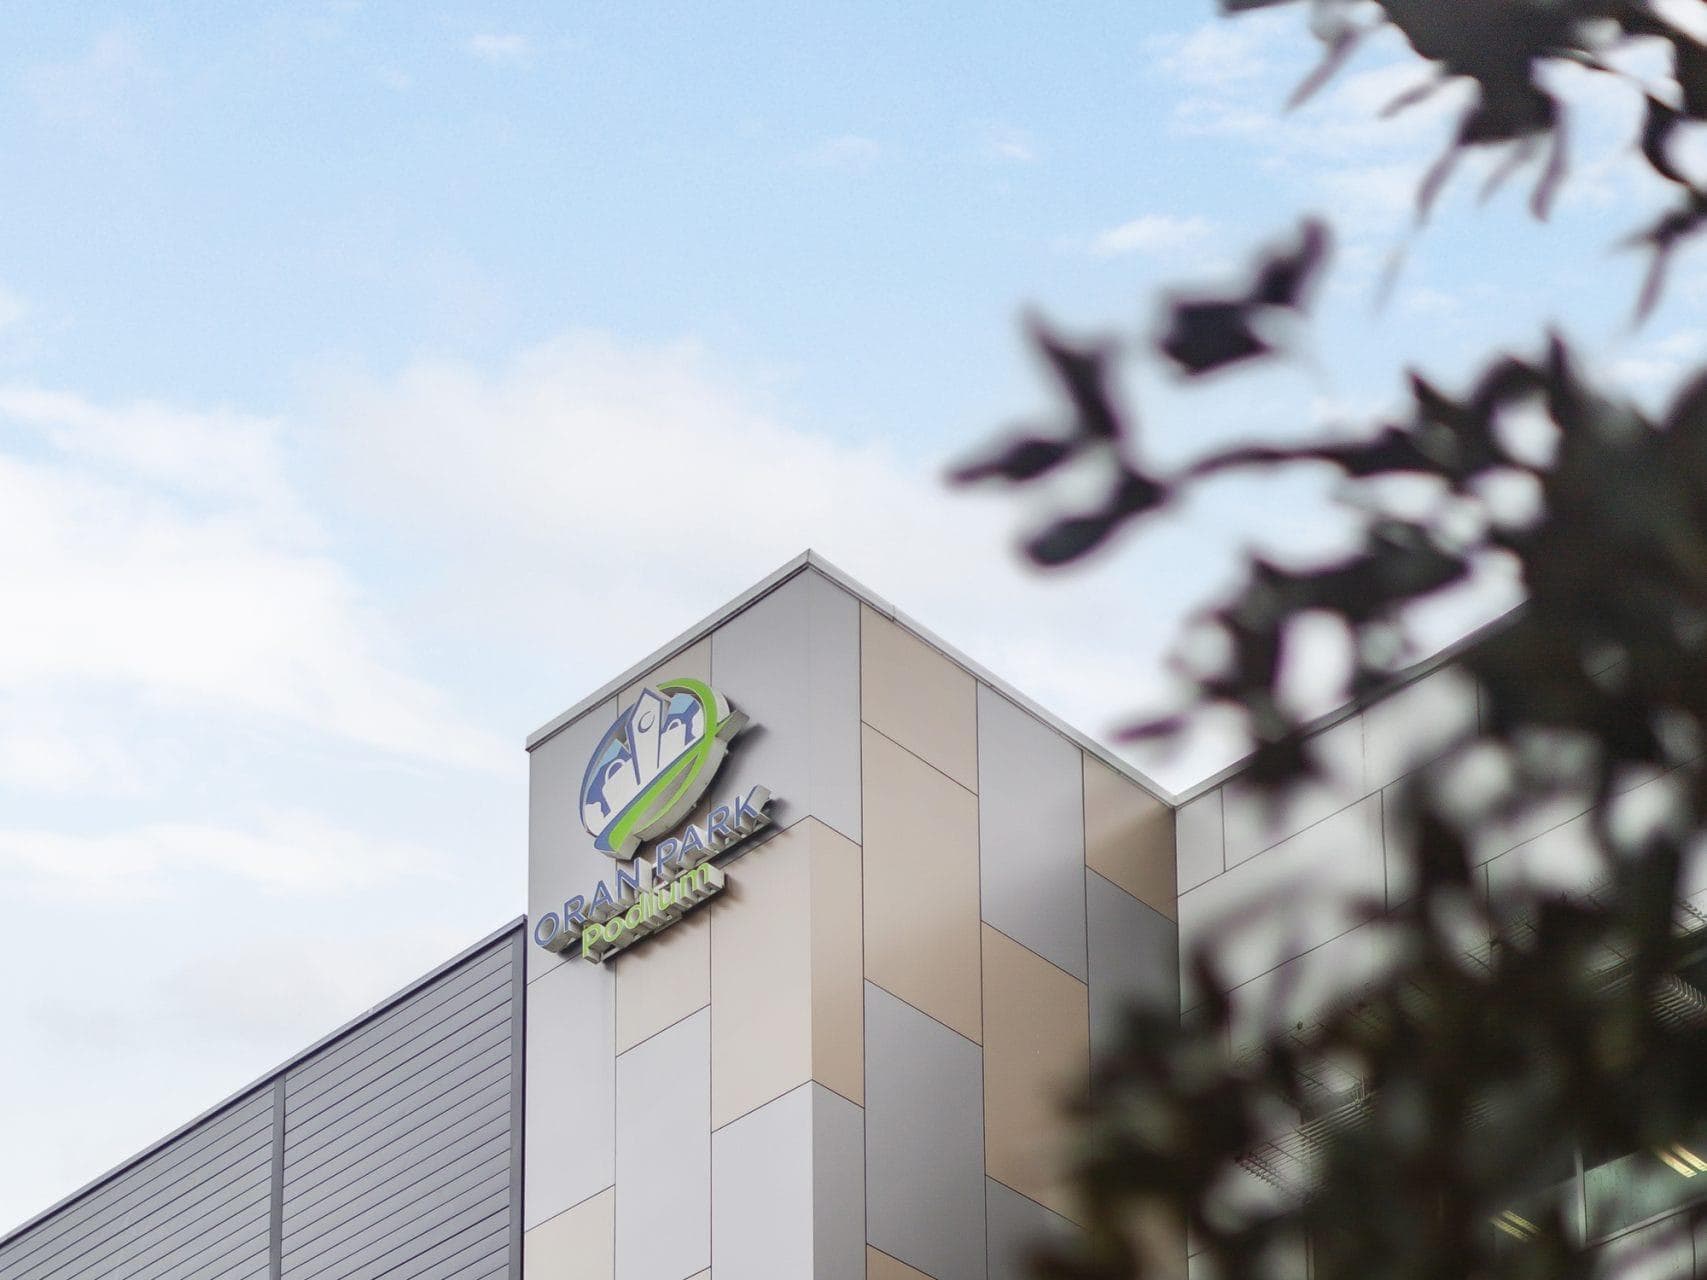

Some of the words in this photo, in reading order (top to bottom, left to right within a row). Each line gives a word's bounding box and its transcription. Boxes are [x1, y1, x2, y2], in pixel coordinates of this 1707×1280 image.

[534, 857, 641, 946] ORAN
[655, 785, 762, 876] PARK
[581, 862, 711, 958] Podium
